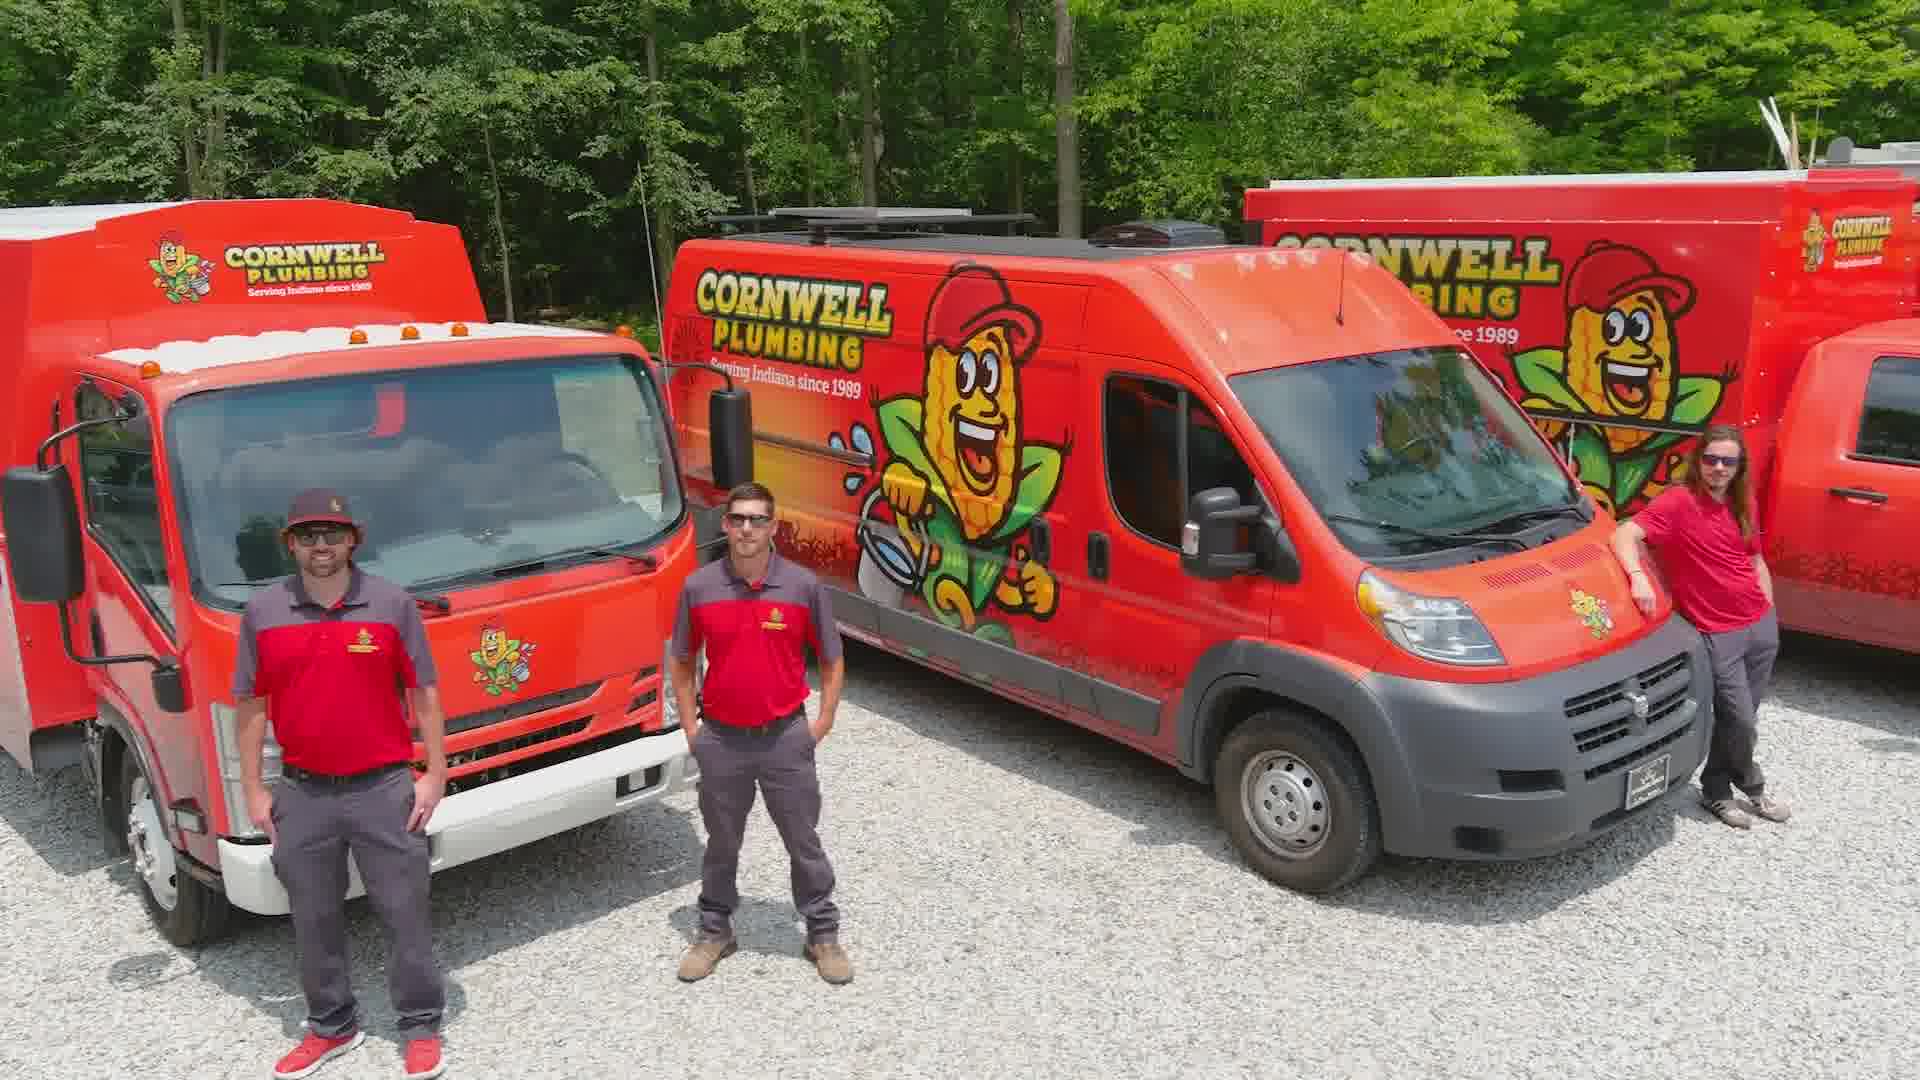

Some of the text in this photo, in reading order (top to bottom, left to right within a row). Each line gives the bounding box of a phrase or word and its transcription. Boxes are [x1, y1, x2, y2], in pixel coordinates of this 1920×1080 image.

[225, 243, 385, 268] CORNWELL
[1276, 237, 1559, 281] NWELL
[247, 264, 368, 283] PLUMBING
[248, 287, 286, 296] Serving
[696, 271, 893, 334] CORNWELL
[713, 320, 862, 370] PLUMBING
[1476, 328, 1518, 344] 1989
[752, 364, 795, 387] Indiana
[799, 373, 830, 393] since
[832, 378, 861, 399] 1989
